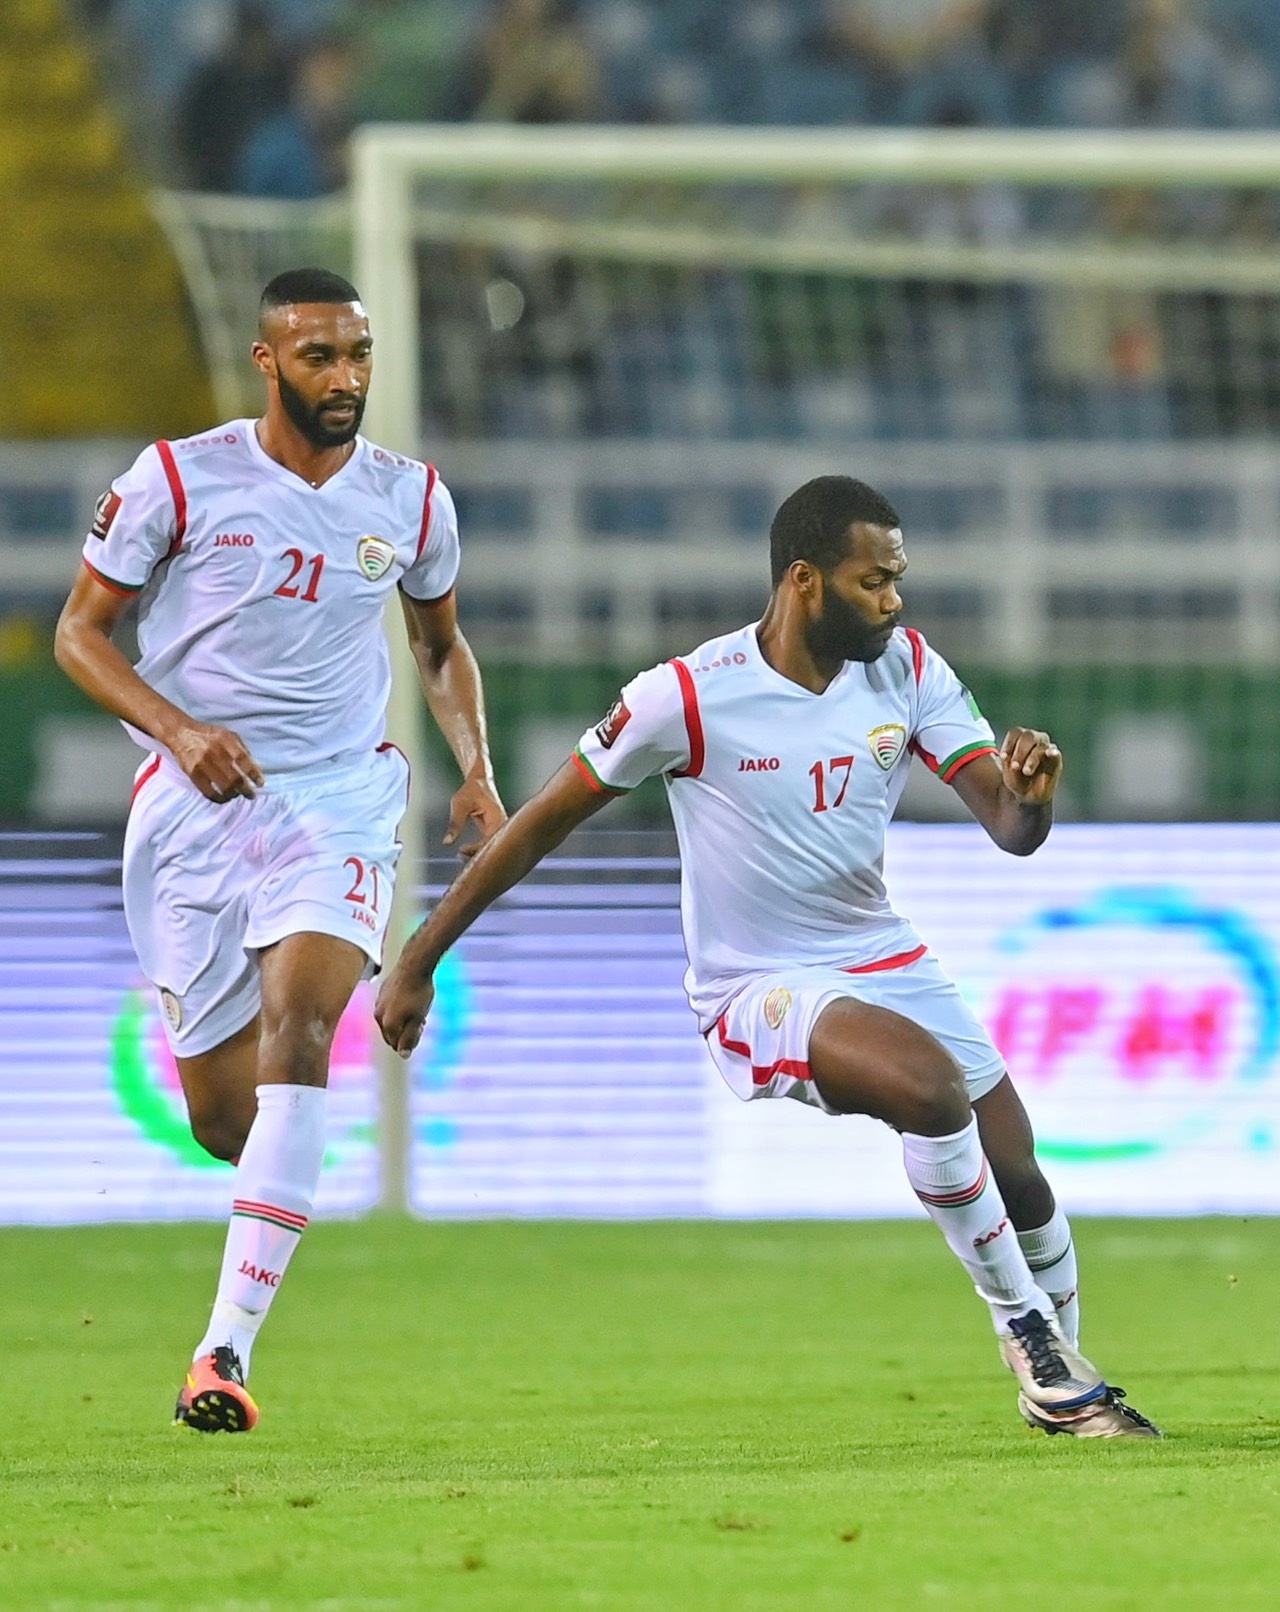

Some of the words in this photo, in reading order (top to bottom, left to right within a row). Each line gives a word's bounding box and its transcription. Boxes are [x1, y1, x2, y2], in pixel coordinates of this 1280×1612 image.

[213, 533, 255, 548] JAKO
[273, 547, 325, 603] 21
[738, 757, 780, 772] JAKO
[808, 755, 854, 813] 17
[342, 856, 379, 914] 21
[351, 908, 376, 931] JAKO
